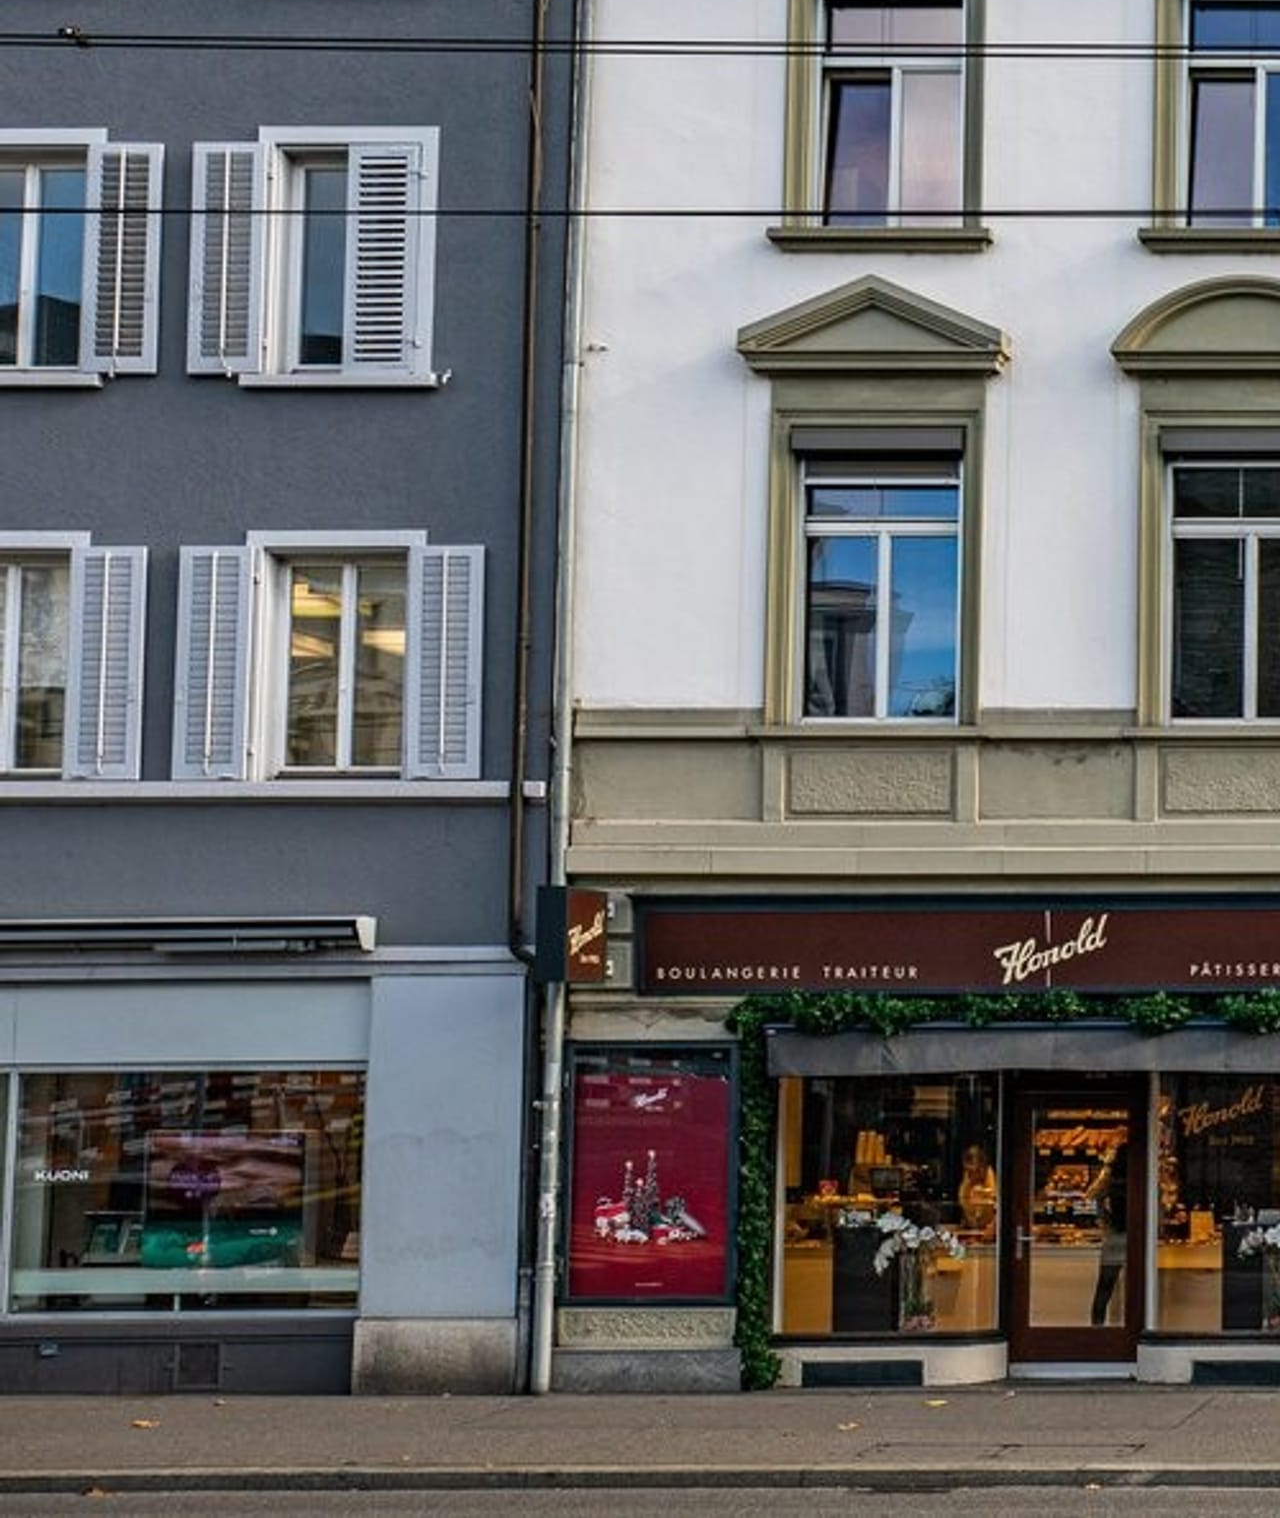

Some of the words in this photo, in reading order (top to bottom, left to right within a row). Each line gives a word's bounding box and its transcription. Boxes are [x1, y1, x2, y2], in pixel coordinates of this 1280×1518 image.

[992, 911, 1110, 986] Honold
[655, 965, 802, 980] BOULANGERIE
[822, 965, 919, 980] TRAITEUR
[1178, 1084, 1264, 1137] Honold
[34, 1169, 89, 1182] KUONI
